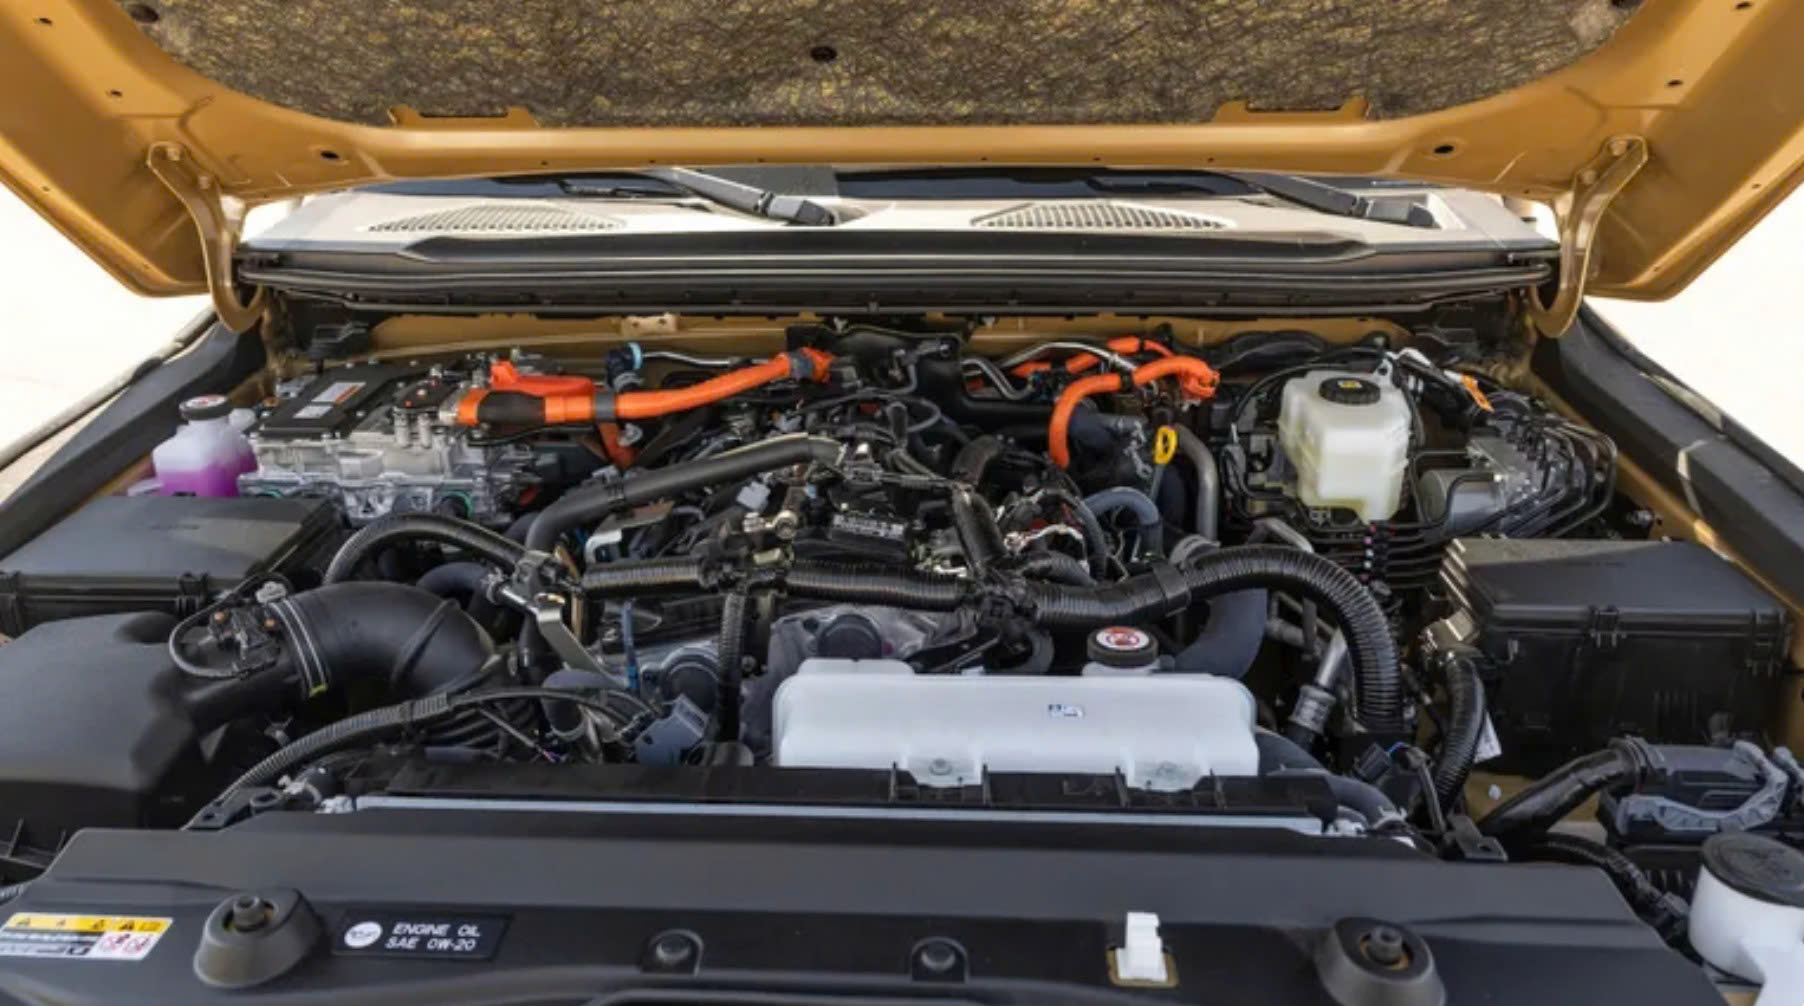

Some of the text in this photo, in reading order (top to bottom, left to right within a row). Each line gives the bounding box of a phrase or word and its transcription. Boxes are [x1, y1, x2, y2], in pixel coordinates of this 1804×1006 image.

[392, 922, 450, 936] ENGINE
[457, 923, 481, 937] OIL
[385, 936, 420, 949] SAE
